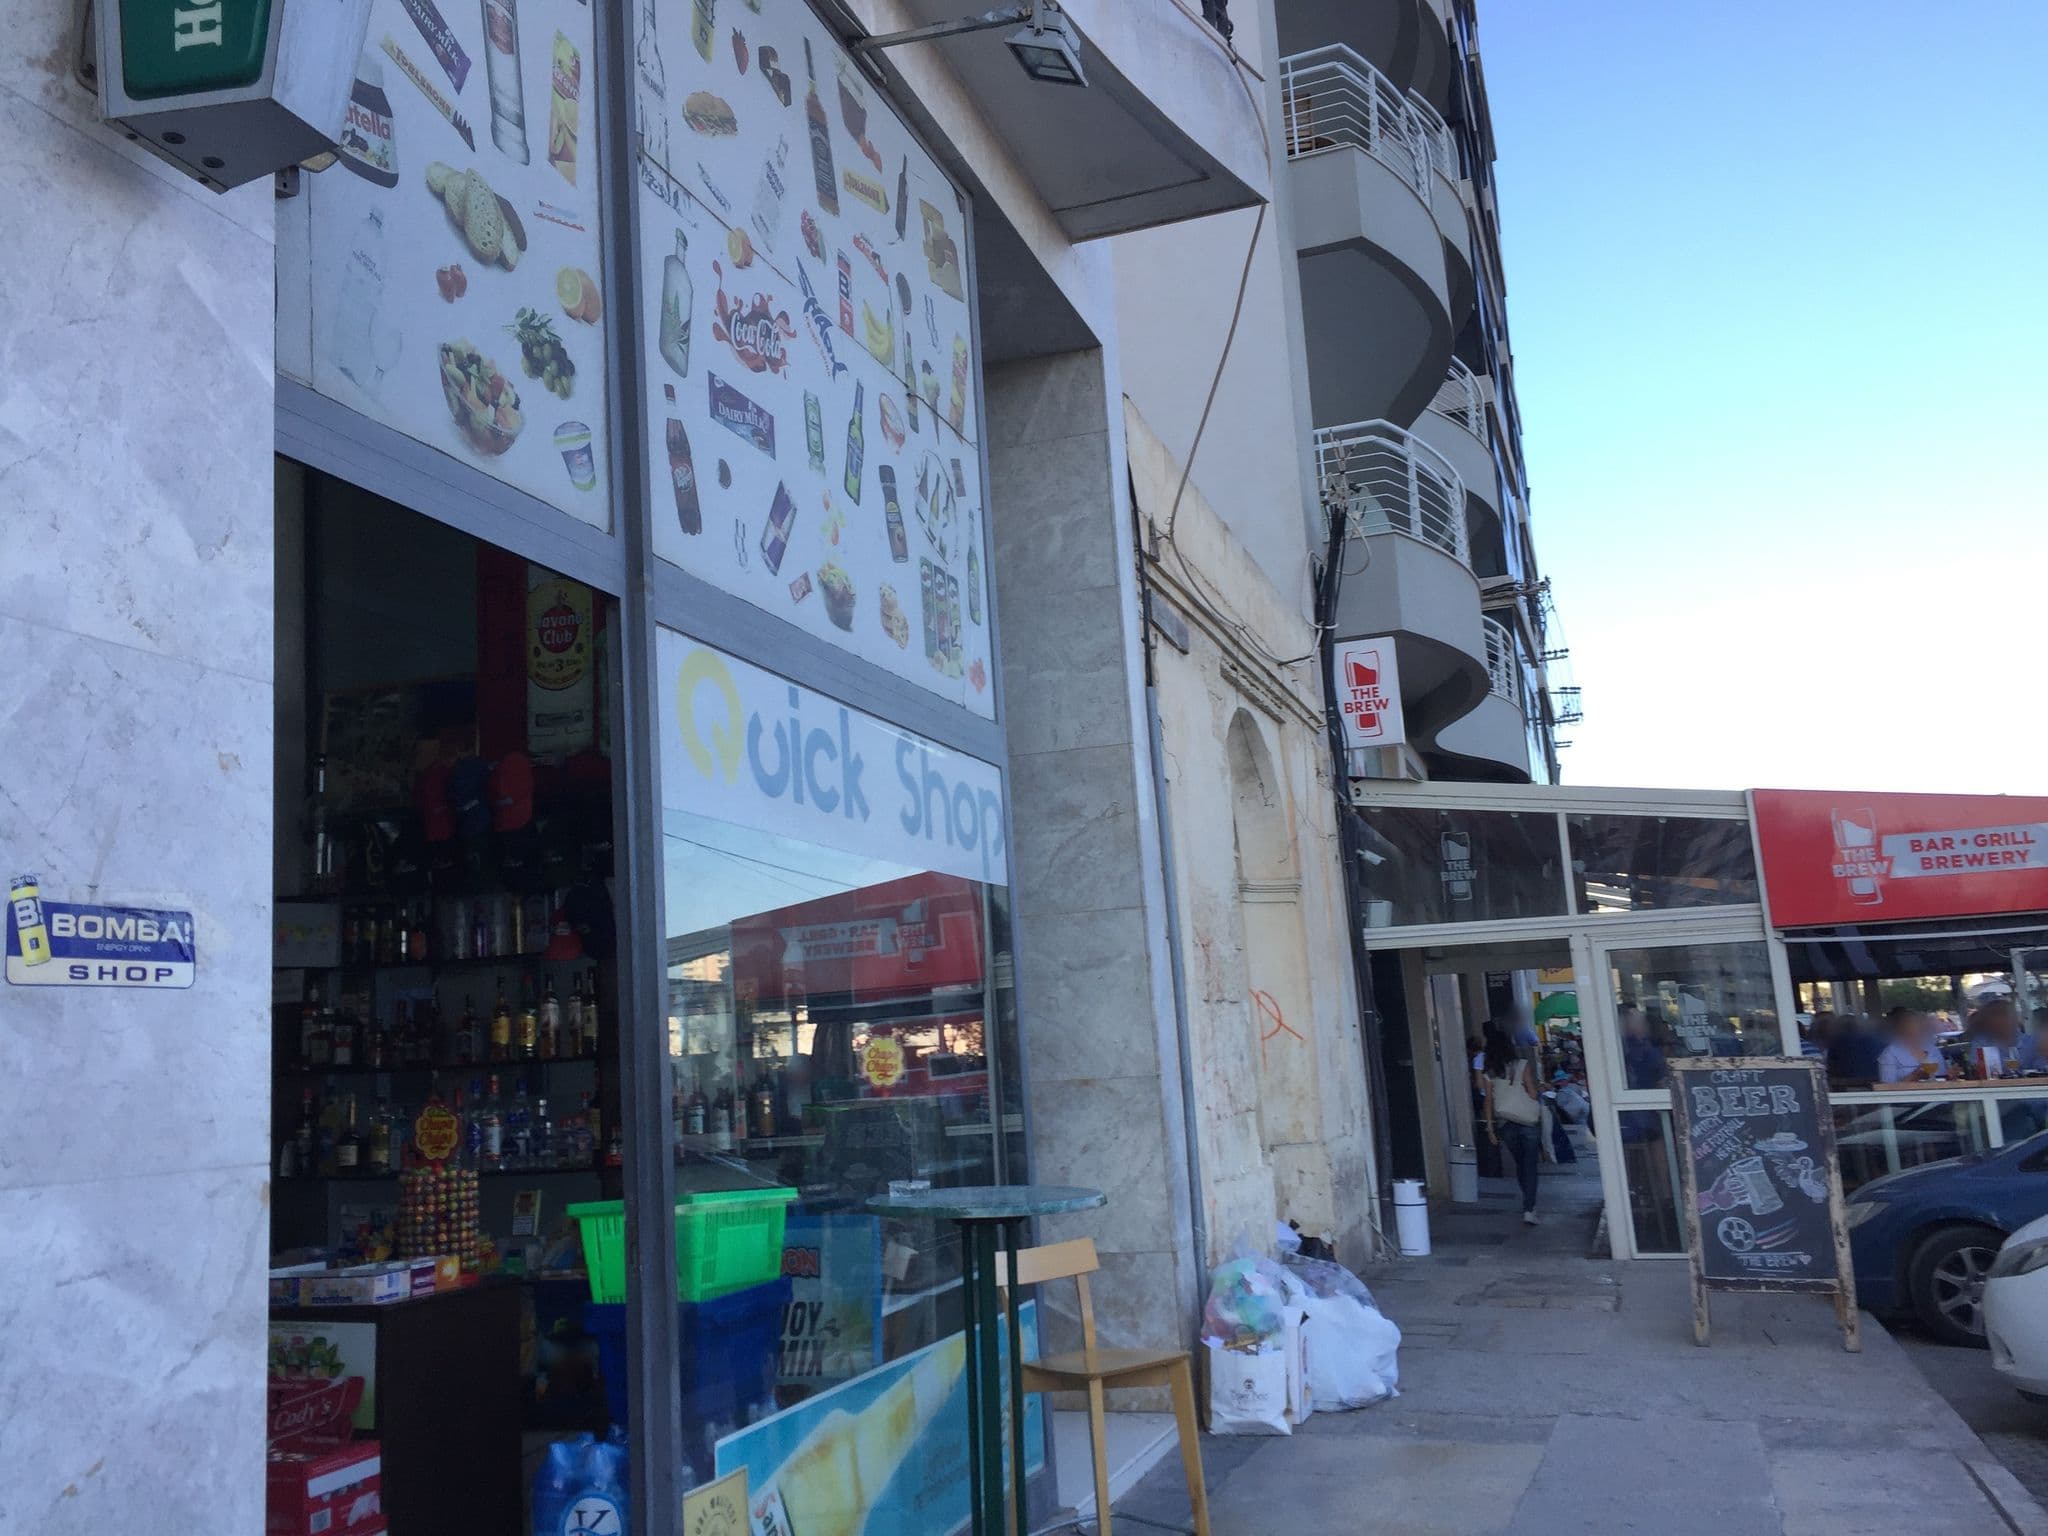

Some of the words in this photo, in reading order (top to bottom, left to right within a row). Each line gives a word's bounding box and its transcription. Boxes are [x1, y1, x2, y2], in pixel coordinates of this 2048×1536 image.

[436, 31, 460, 67] MILK
[345, 104, 391, 140] utella
[718, 402, 746, 424] DAIRY
[744, 408, 768, 434] MILK
[1350, 686, 1380, 701] THE
[1343, 698, 1390, 715] BREW
[675, 648, 871, 824] Quick
[895, 732, 1004, 881] Shop
[1909, 837, 1956, 854] BAR
[1973, 830, 2037, 848] GRILL
[1841, 846, 1877, 862] THE
[1920, 849, 2032, 871] BREWERY
[1446, 859, 1471, 871] THE
[1832, 860, 1891, 878] BREW
[1440, 869, 1478, 882] BREW
[51, 912, 192, 944] BOMBA!
[68, 964, 174, 982] SHOP
[1710, 1069, 1765, 1084] CRAFT
[1691, 1084, 1800, 1117] BEER
